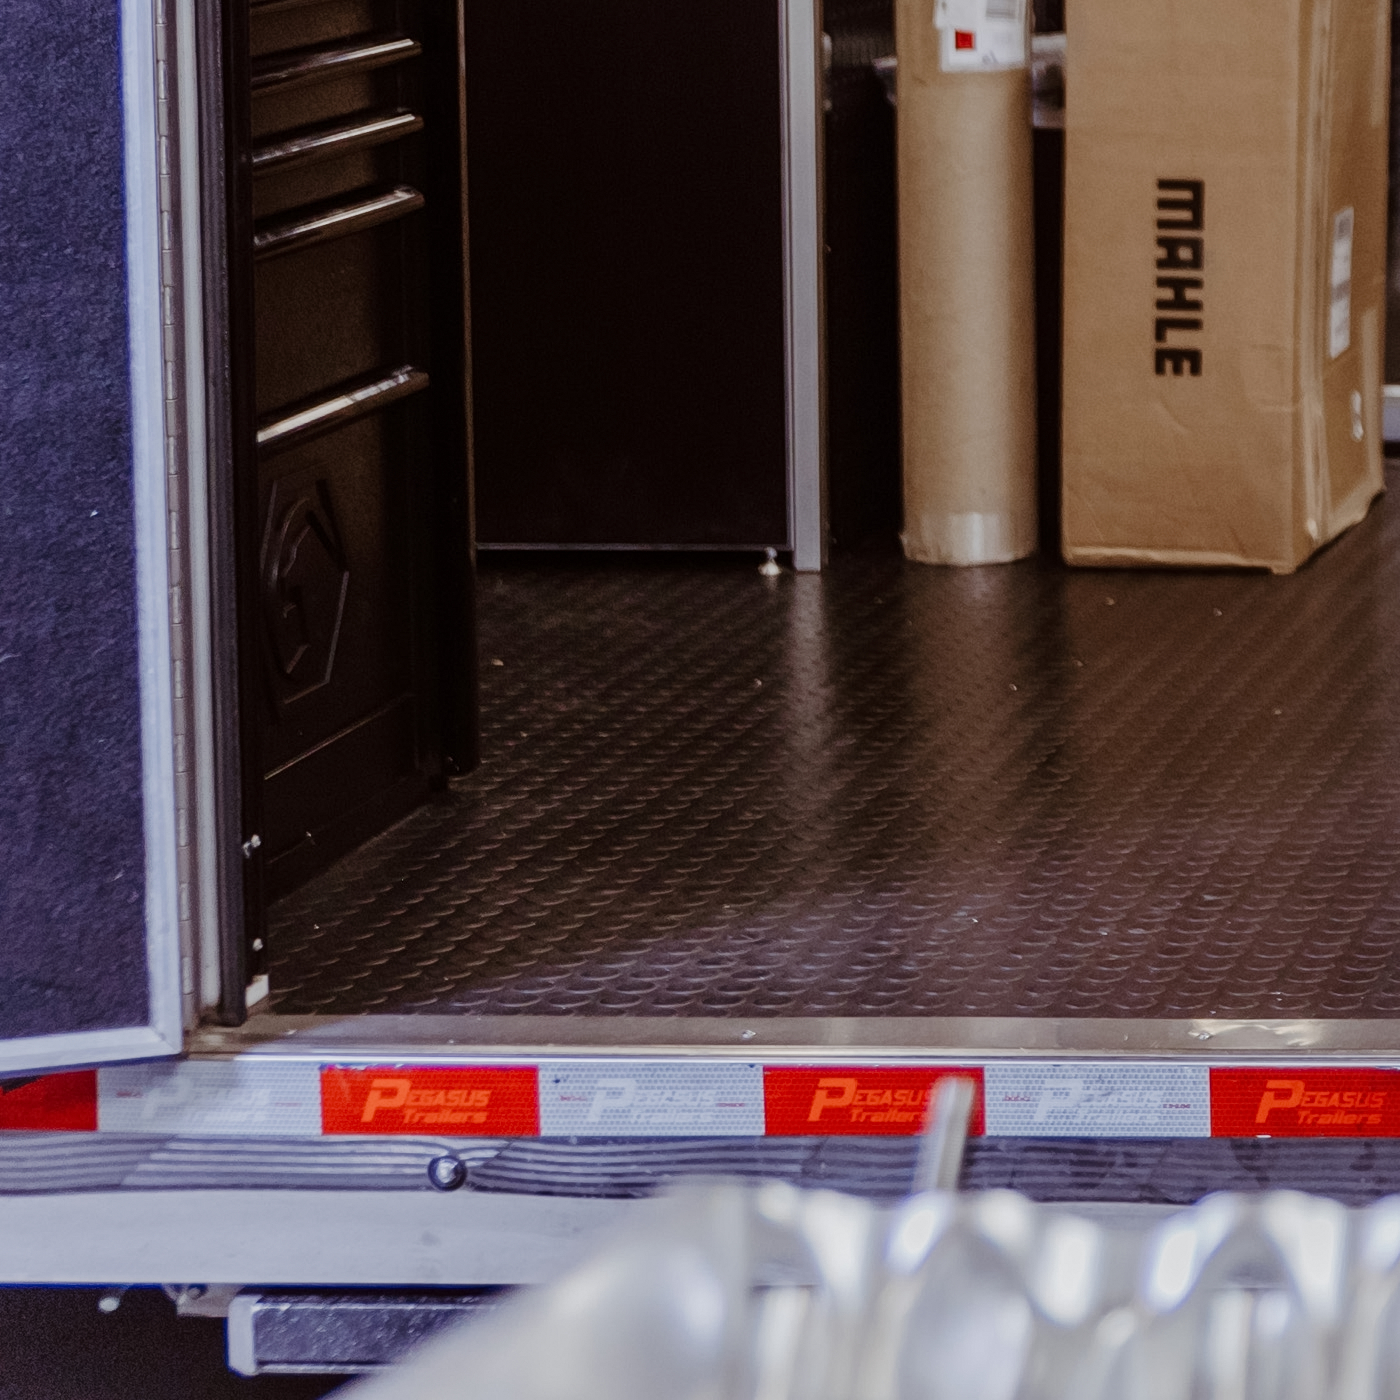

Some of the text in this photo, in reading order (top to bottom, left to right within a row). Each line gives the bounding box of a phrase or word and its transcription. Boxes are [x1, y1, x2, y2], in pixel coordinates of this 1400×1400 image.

[1154, 178, 1205, 377] MAHLE
[361, 1078, 492, 1122] PEGASUS
[403, 1107, 488, 1123] Trailers
[1255, 1080, 1388, 1123] PEGASUS
[1298, 1110, 1383, 1125] Trailers
